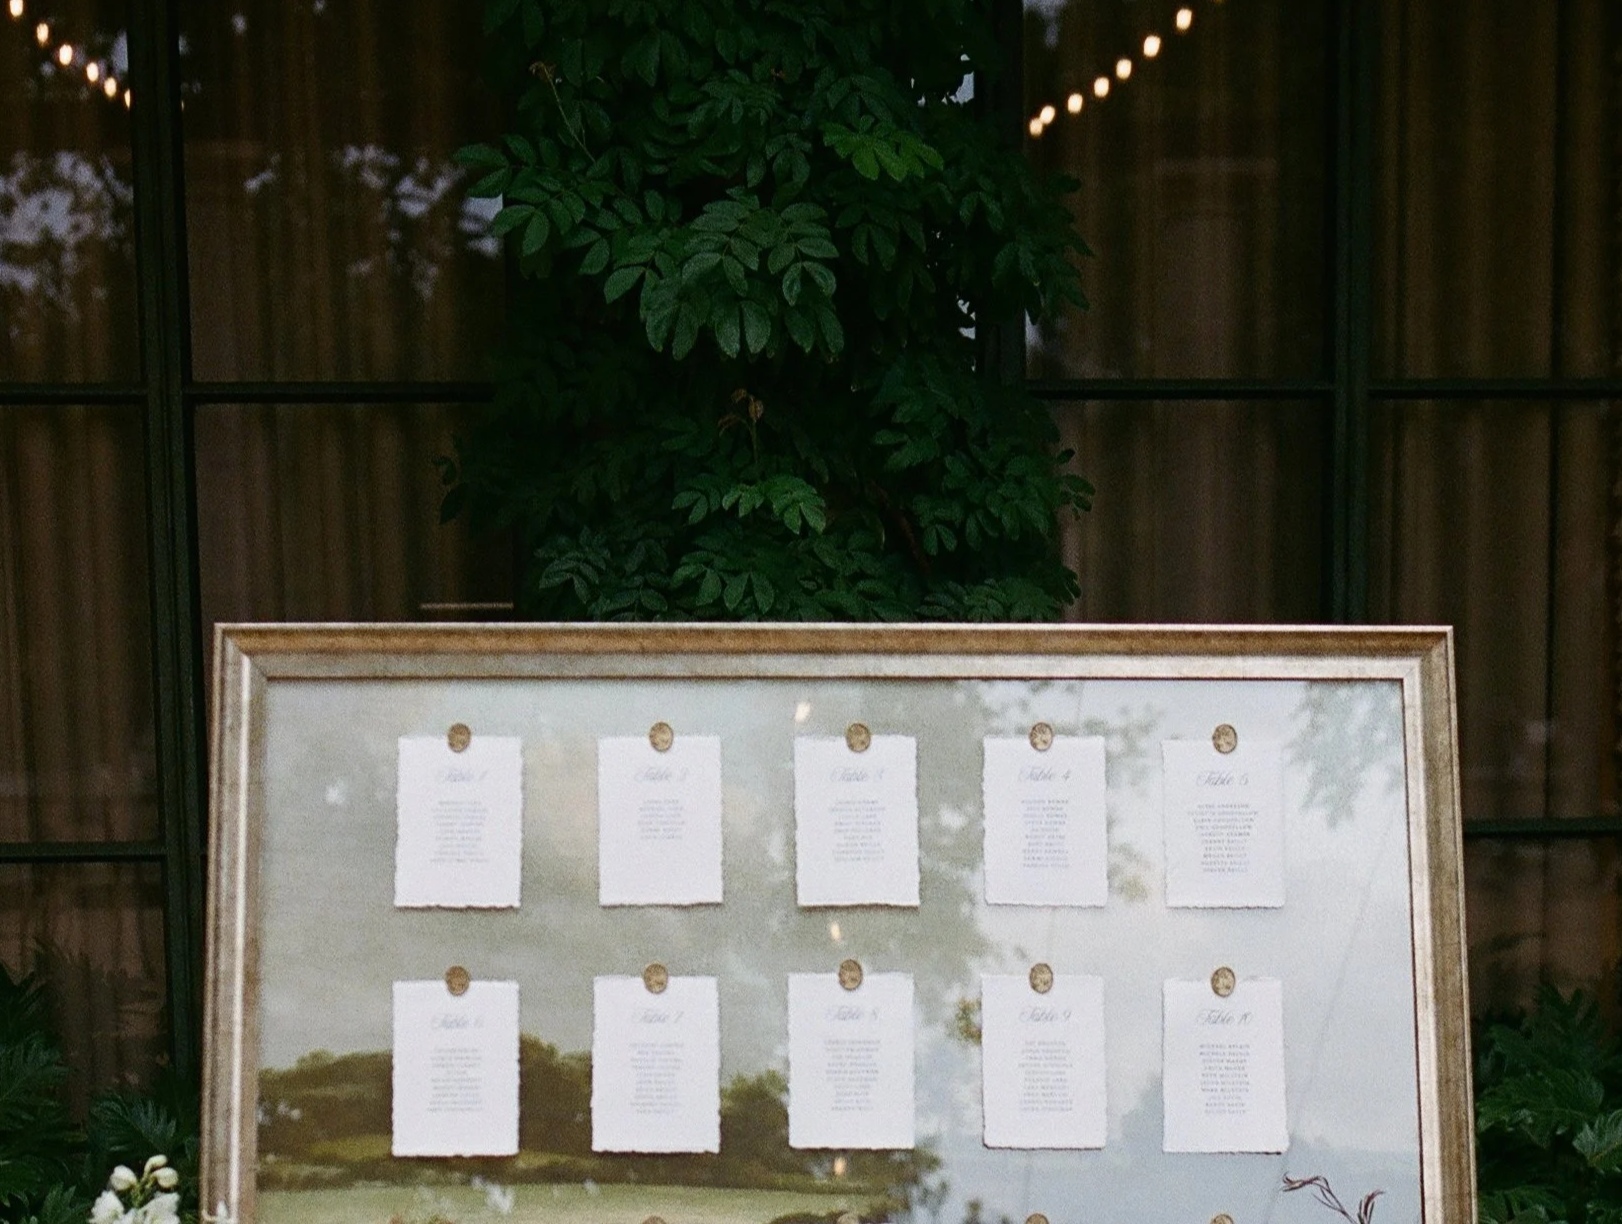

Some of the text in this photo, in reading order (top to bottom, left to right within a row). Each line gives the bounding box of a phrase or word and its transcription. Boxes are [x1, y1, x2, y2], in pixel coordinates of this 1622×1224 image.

[435, 768, 474, 782] Table
[635, 768, 673, 782] Table
[830, 768, 869, 781] Table
[1019, 767, 1071, 781] Table 4
[1197, 772, 1235, 786] Table
[632, 1010, 685, 1024] Table 7
[825, 1006, 864, 1020] Table
[1019, 1007, 1072, 1022] Table 9
[1197, 1010, 1253, 1025] Table 10
[431, 1015, 469, 1029] Table
